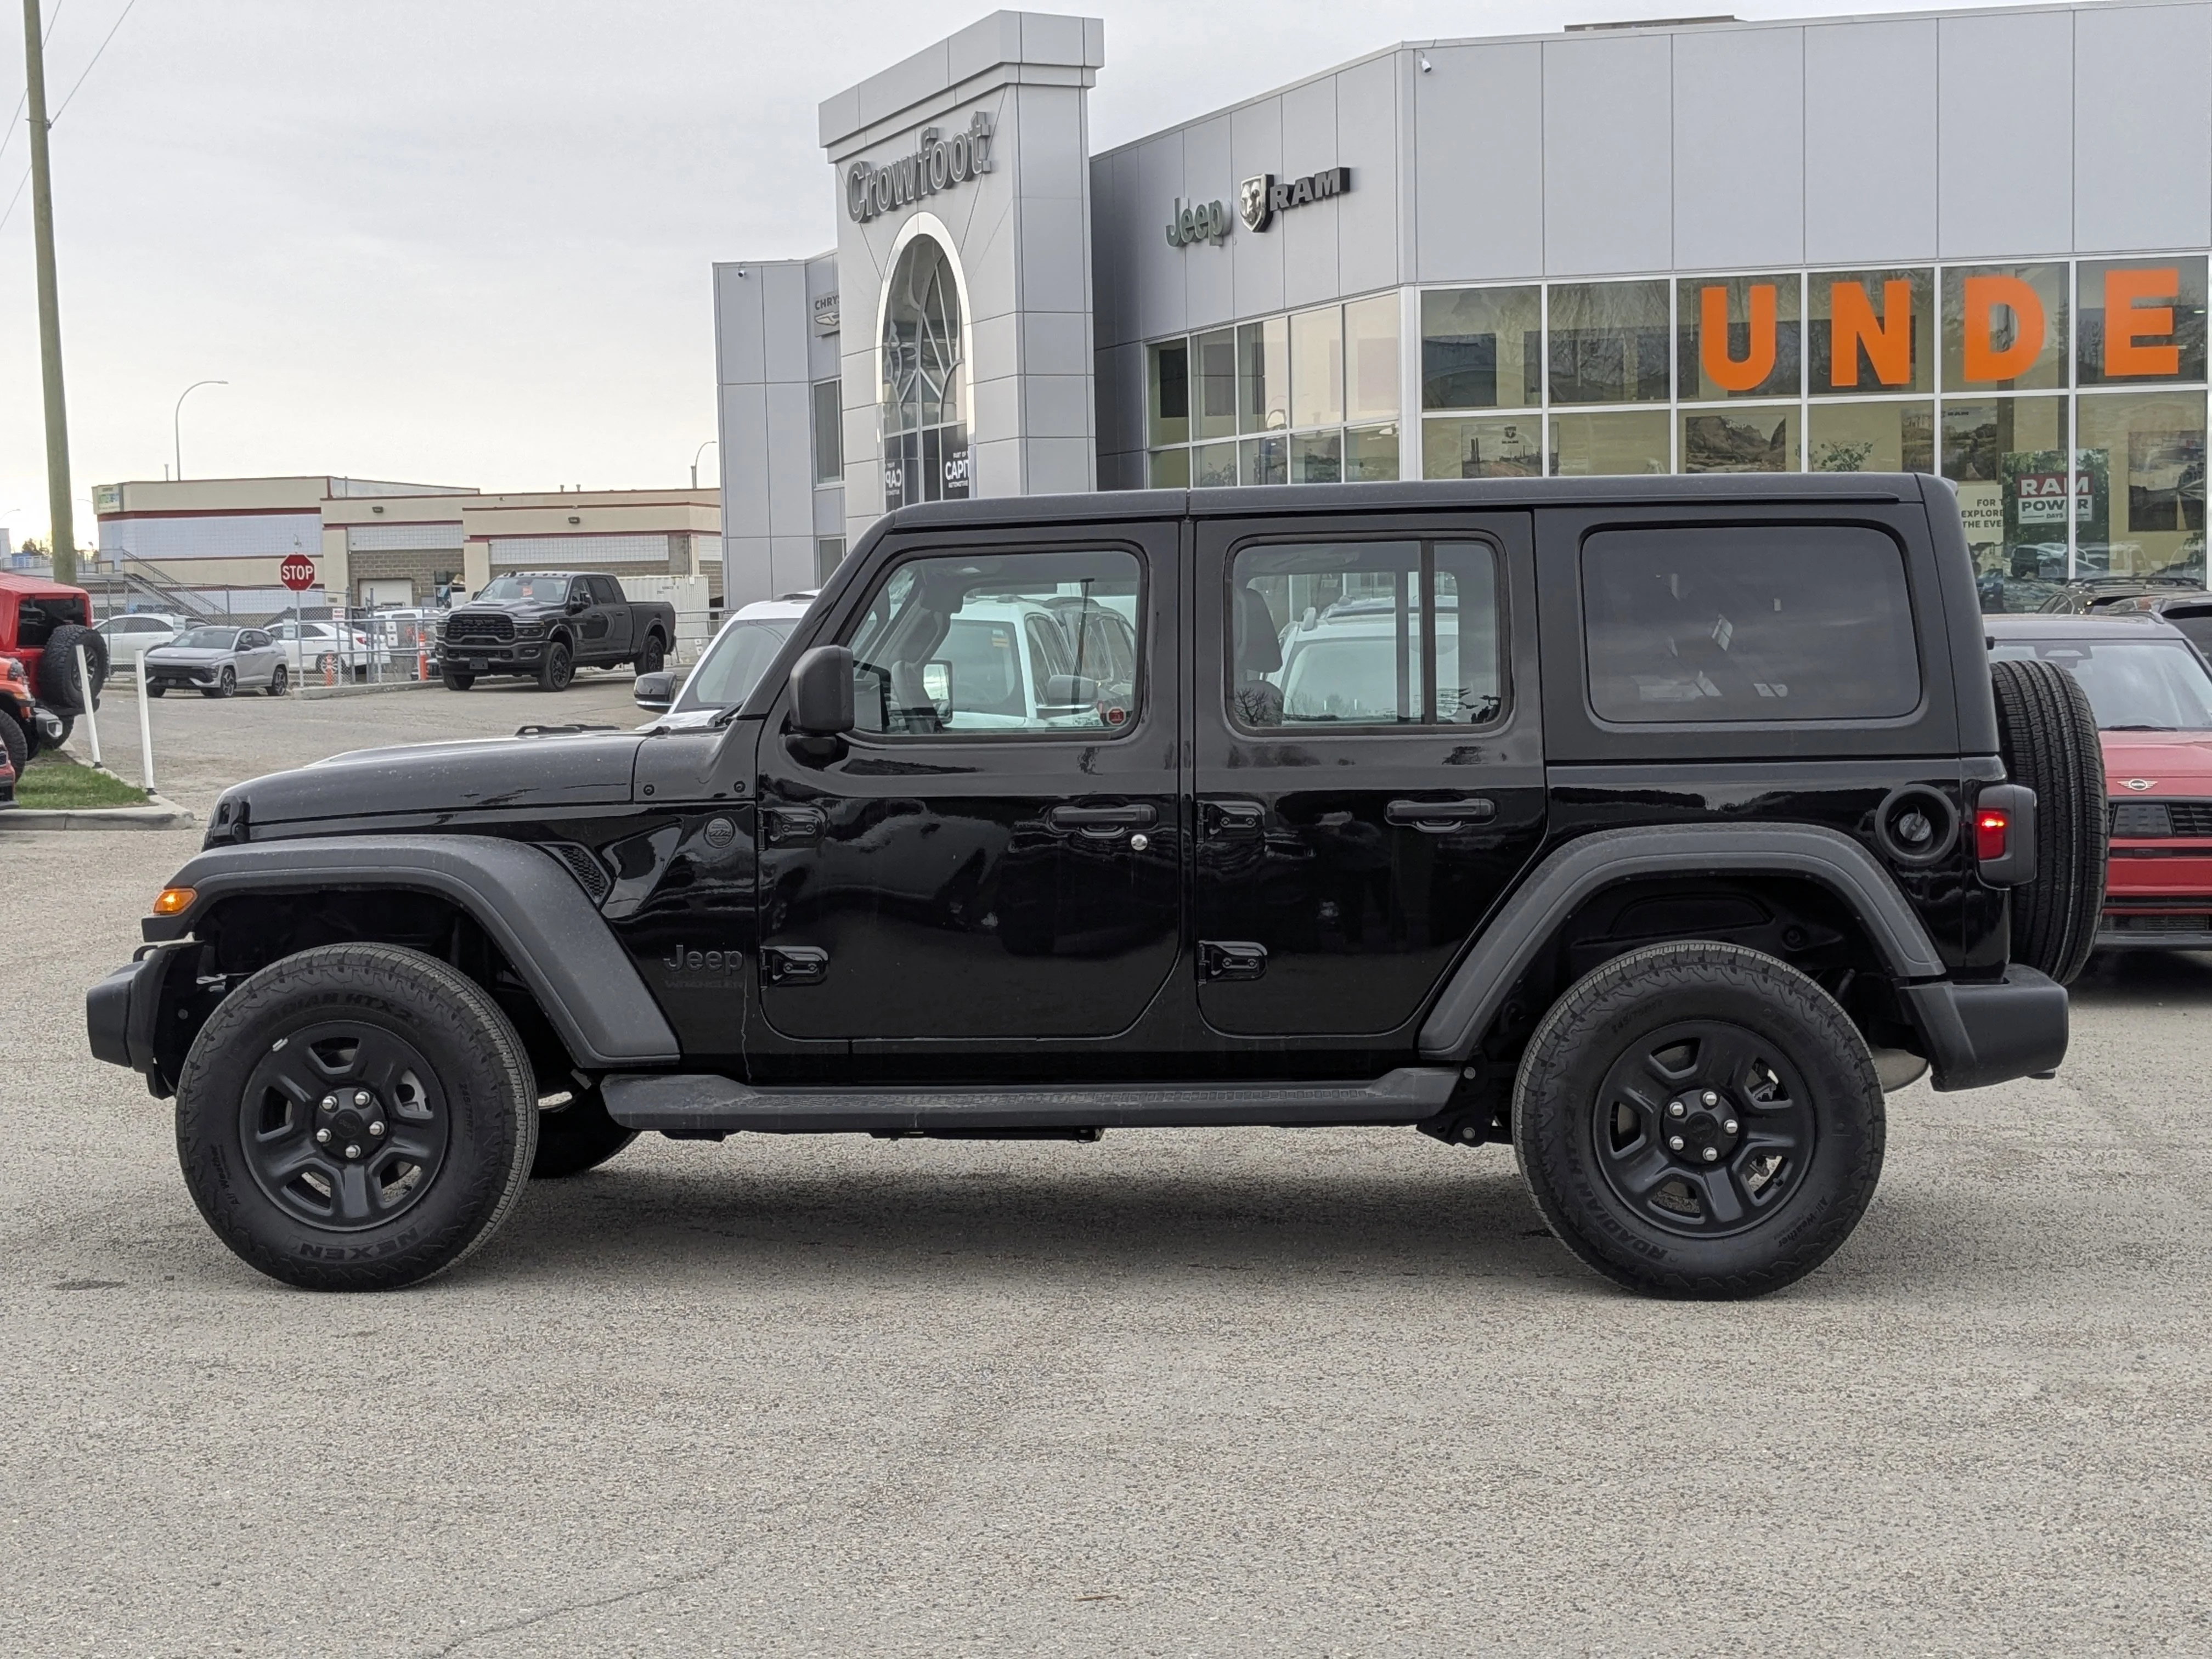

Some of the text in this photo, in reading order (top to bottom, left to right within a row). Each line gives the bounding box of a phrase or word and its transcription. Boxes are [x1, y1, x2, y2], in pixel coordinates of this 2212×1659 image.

[846, 111, 992, 223] Crowfoot
[1270, 167, 1350, 211] RAM
[1165, 197, 1229, 247] Jeep
[2021, 477, 2089, 496] RAM
[1977, 499, 1996, 507] FOR
[2022, 499, 2089, 512] POWR
[1963, 520, 1980, 528] THE
[283, 565, 313, 580] STOP
[663, 944, 744, 976] Jeep
[300, 1229, 421, 1260] NEXEN
